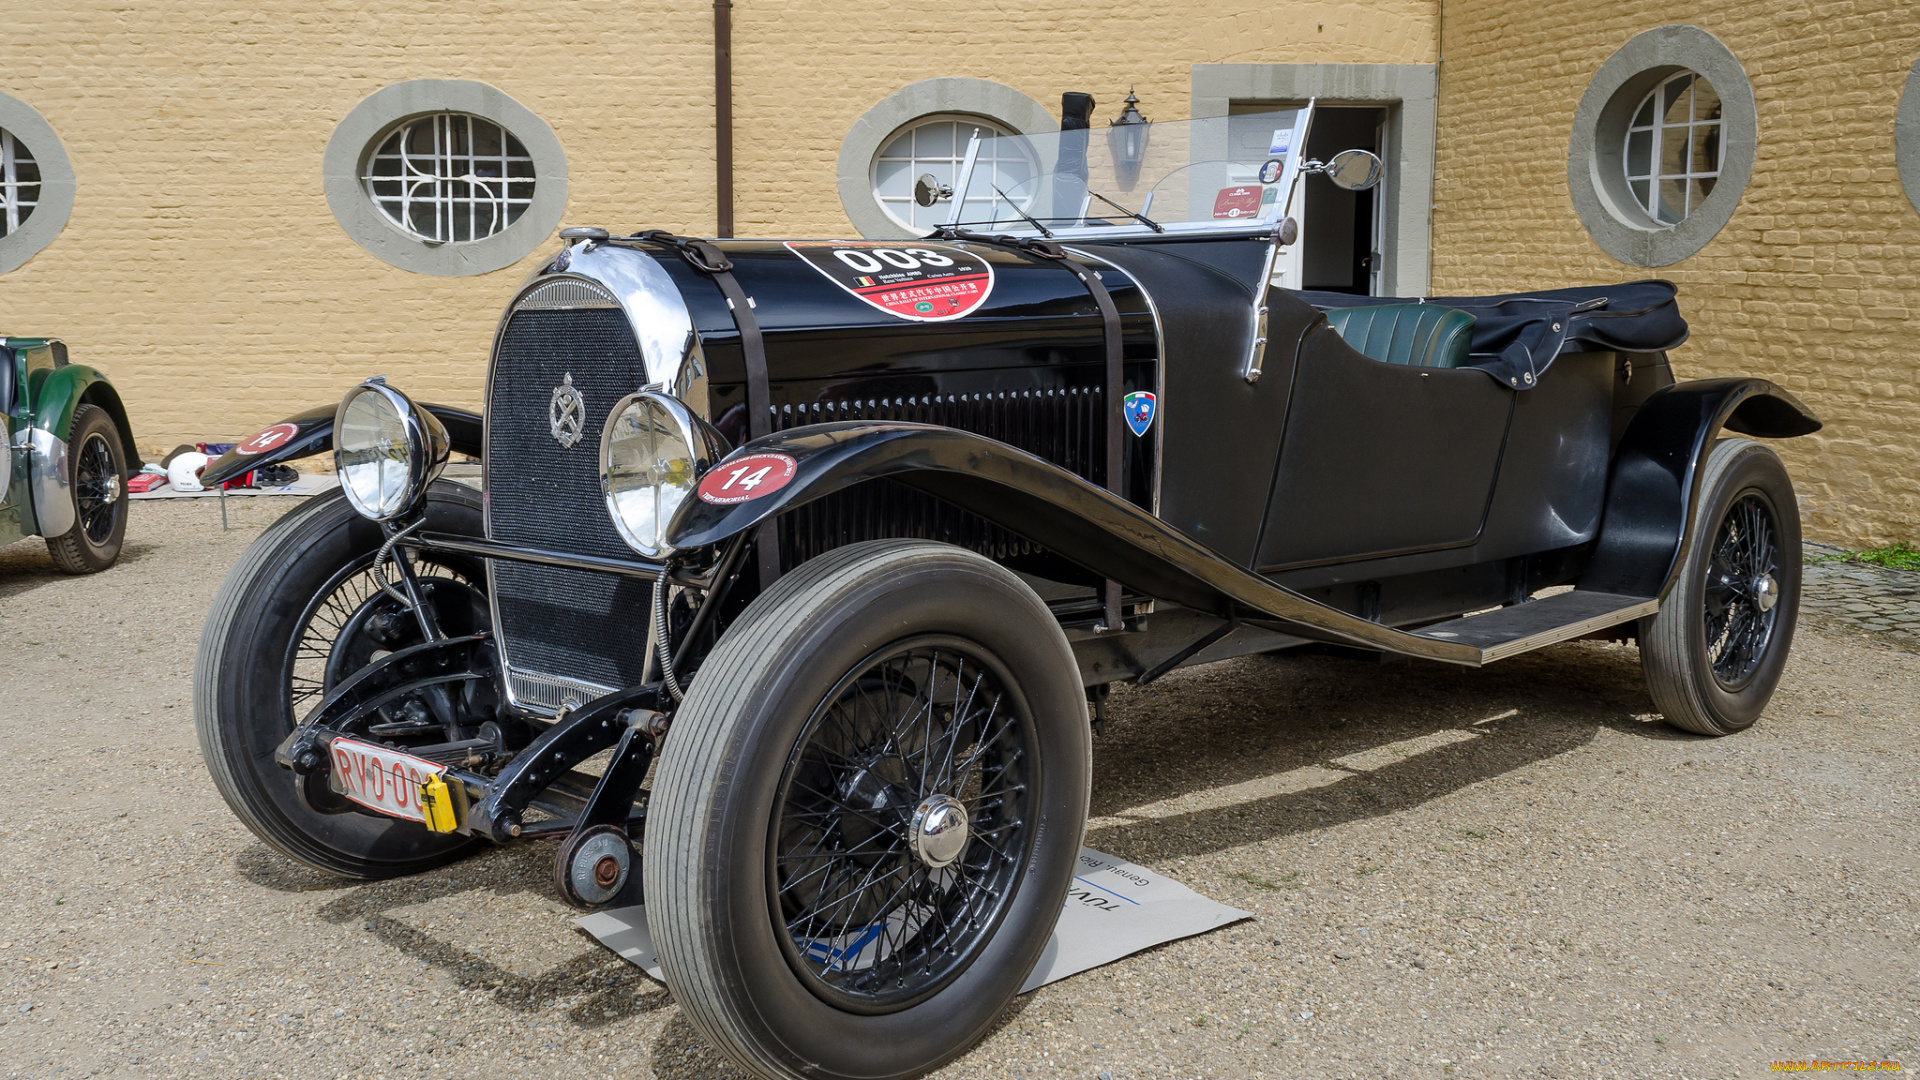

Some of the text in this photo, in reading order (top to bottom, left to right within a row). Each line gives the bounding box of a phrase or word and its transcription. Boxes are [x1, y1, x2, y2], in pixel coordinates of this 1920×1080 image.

[833, 249, 954, 273] 003
[881, 282, 978, 303] 世界老式汽车中国公开赛
[918, 293, 951, 301] INTERNATIONAL
[247, 430, 284, 449] 14
[721, 465, 773, 491] 14
[713, 494, 750, 503] MEMORIAL
[335, 748, 431, 812] RVO-00
[1105, 864, 1150, 887] Genau.
